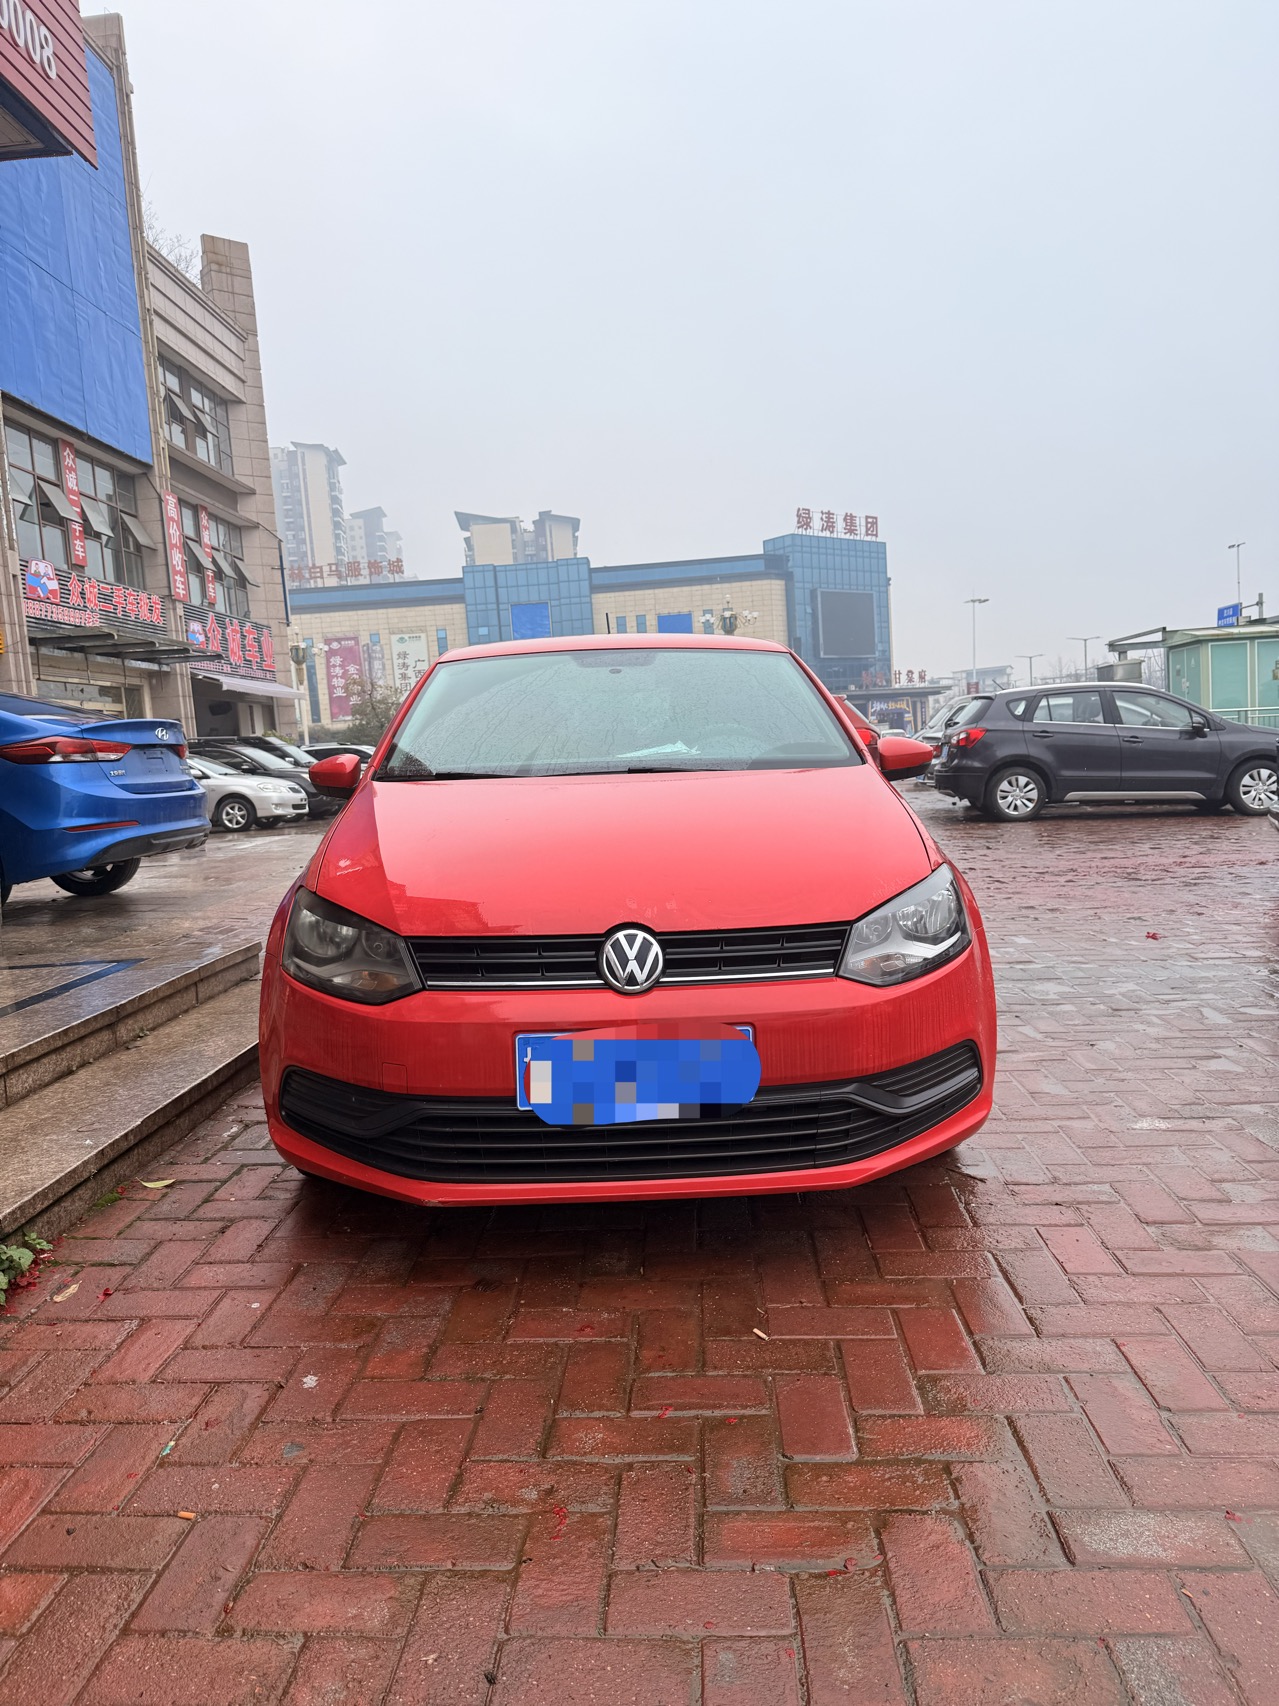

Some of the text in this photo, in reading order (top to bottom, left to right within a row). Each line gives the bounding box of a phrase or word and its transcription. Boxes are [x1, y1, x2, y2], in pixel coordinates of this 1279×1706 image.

[796, 507, 878, 537] 绿涛集团
[165, 494, 186, 598] 高价收车
[68, 572, 163, 624] 众诚二手车批发
[206, 612, 276, 669] 众诚车业
[329, 655, 346, 697] 绿涛物业
[396, 650, 412, 691] 绿涛集团
